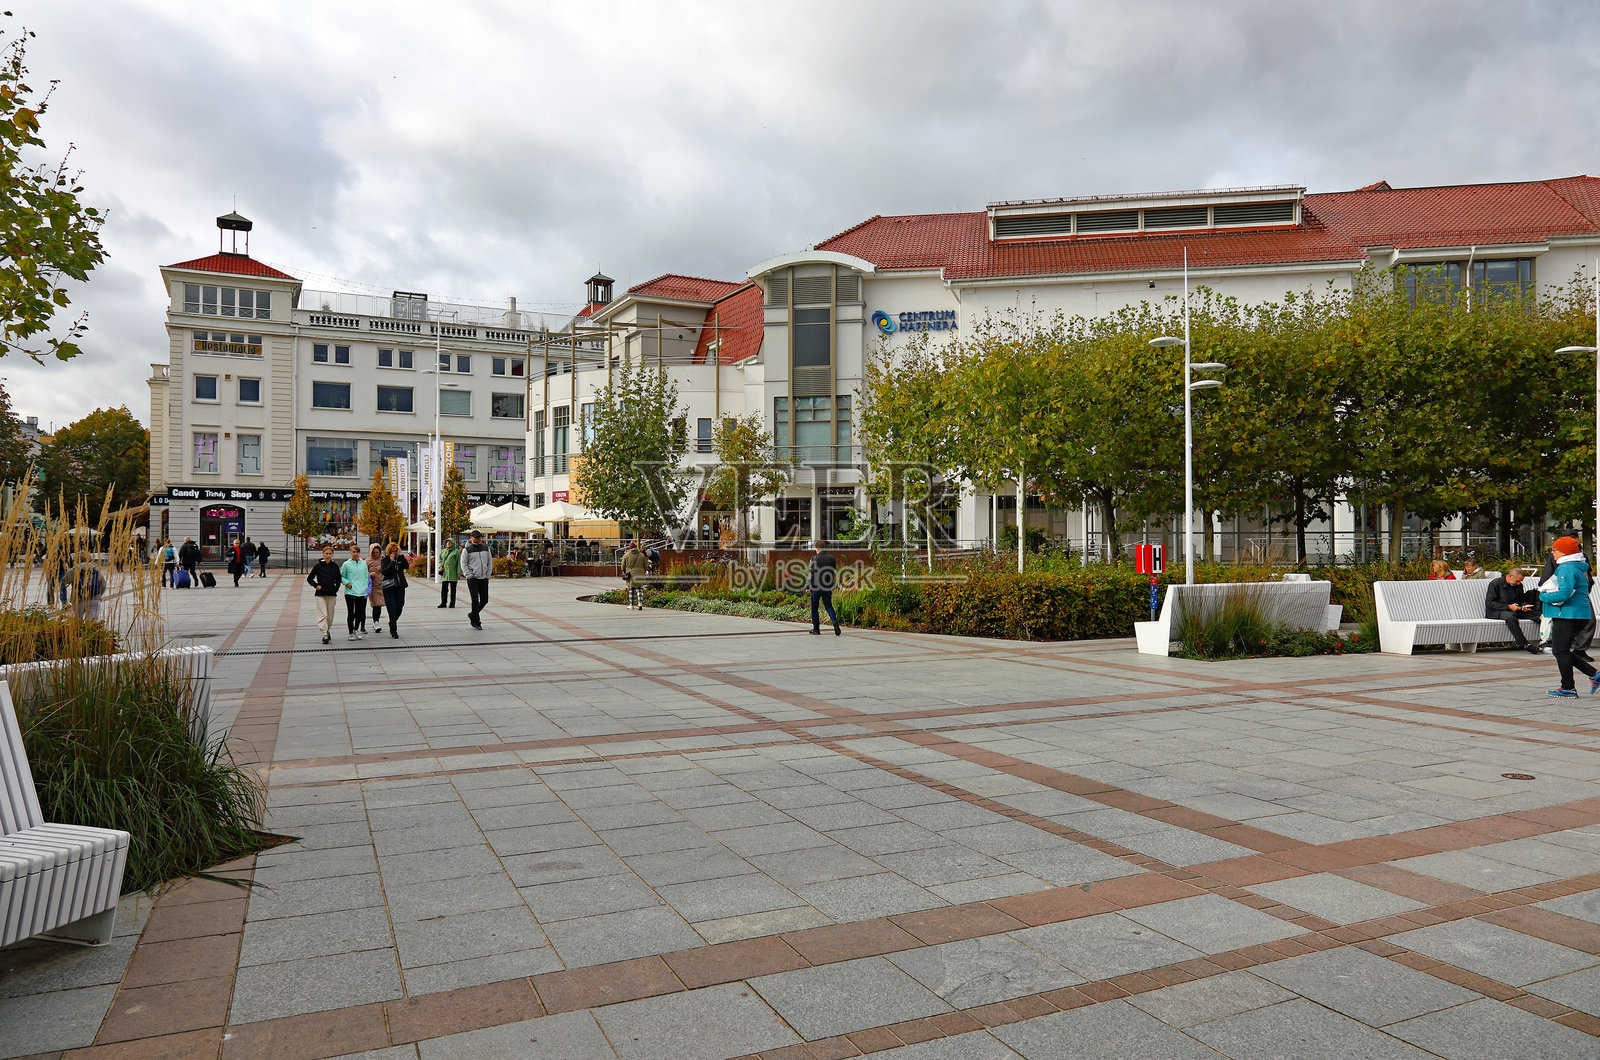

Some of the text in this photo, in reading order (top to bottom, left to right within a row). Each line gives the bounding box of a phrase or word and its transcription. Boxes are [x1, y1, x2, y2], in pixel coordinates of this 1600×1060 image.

[899, 310, 956, 322] CENTRUM
[899, 320, 958, 333] HAFFNERA
[172, 488, 200, 499] Candy
[230, 490, 252, 500] Shop
[309, 491, 328, 499] Candy
[346, 491, 361, 499] Shop
